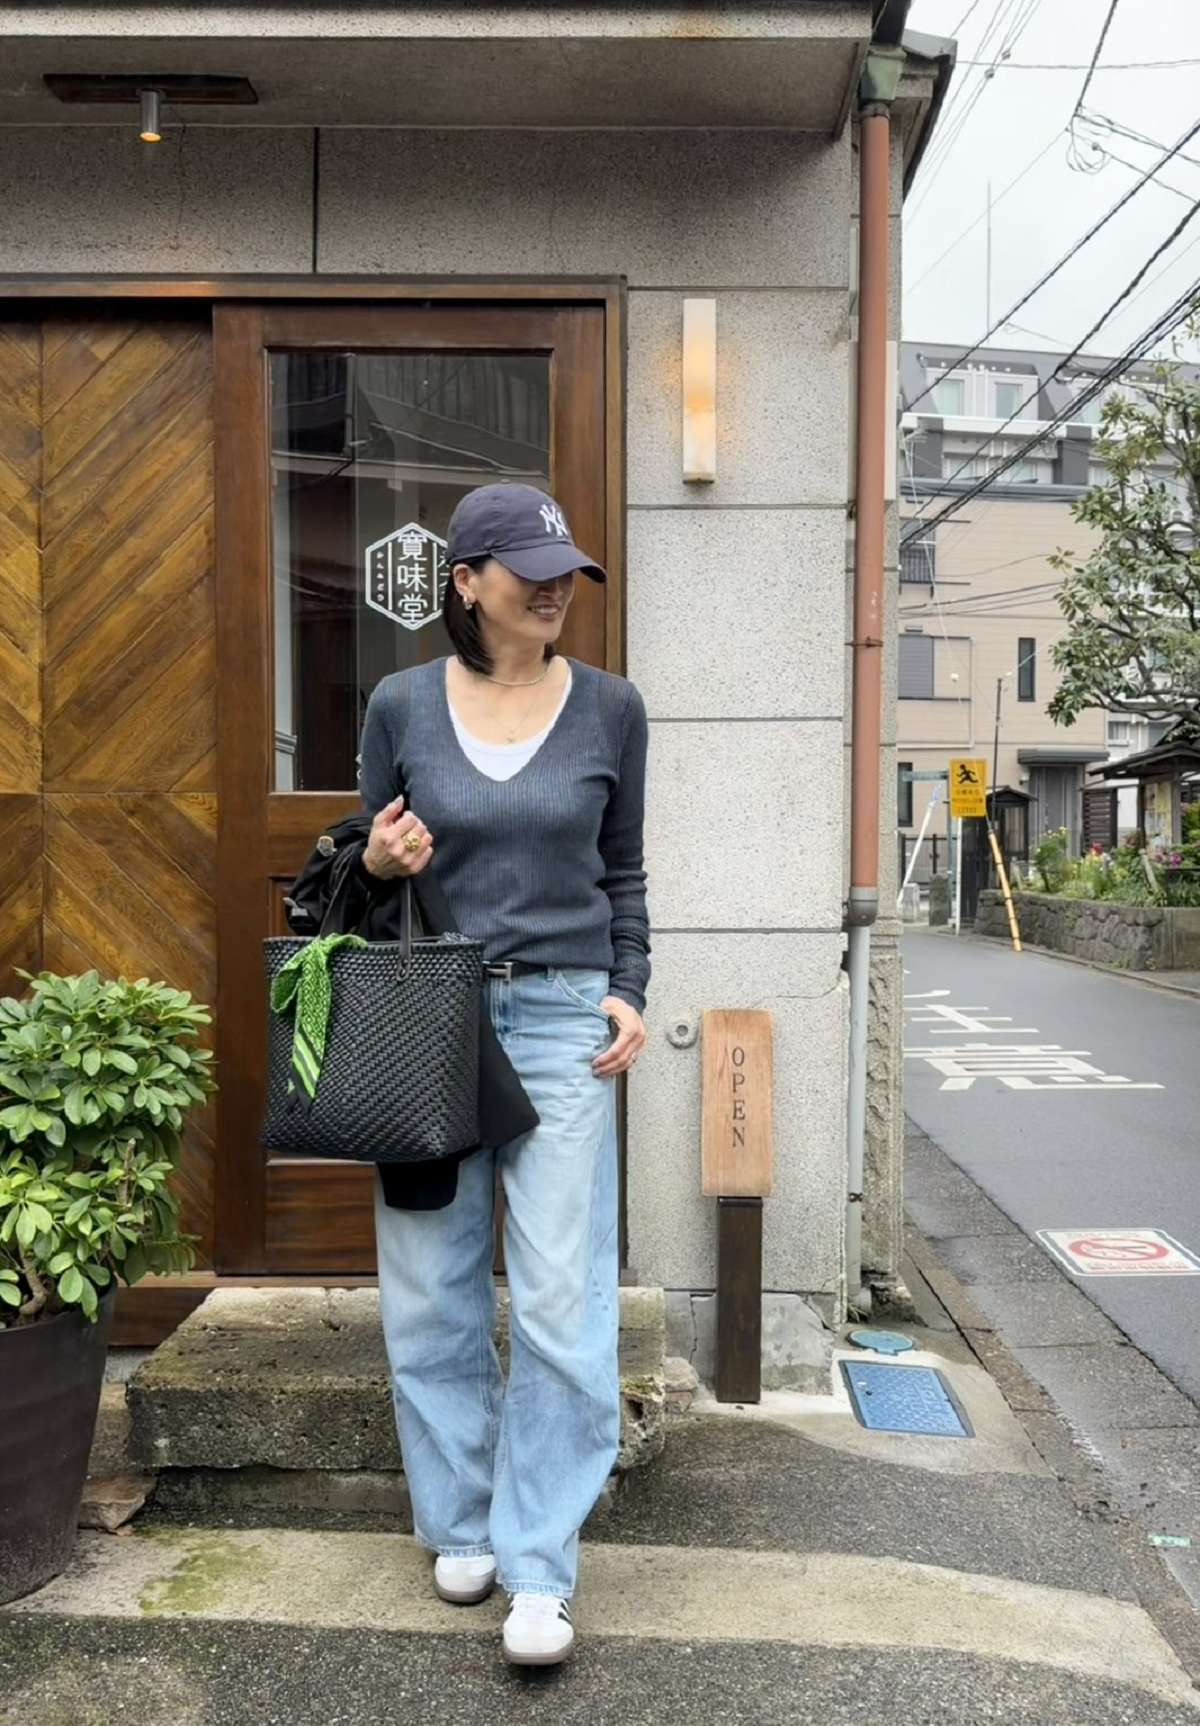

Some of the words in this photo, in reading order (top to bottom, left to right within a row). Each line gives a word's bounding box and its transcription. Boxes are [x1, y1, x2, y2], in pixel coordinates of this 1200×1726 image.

[539, 503, 568, 537] NY
[397, 531, 428, 622] 寛味堂
[732, 1046, 746, 1148] OPEN
